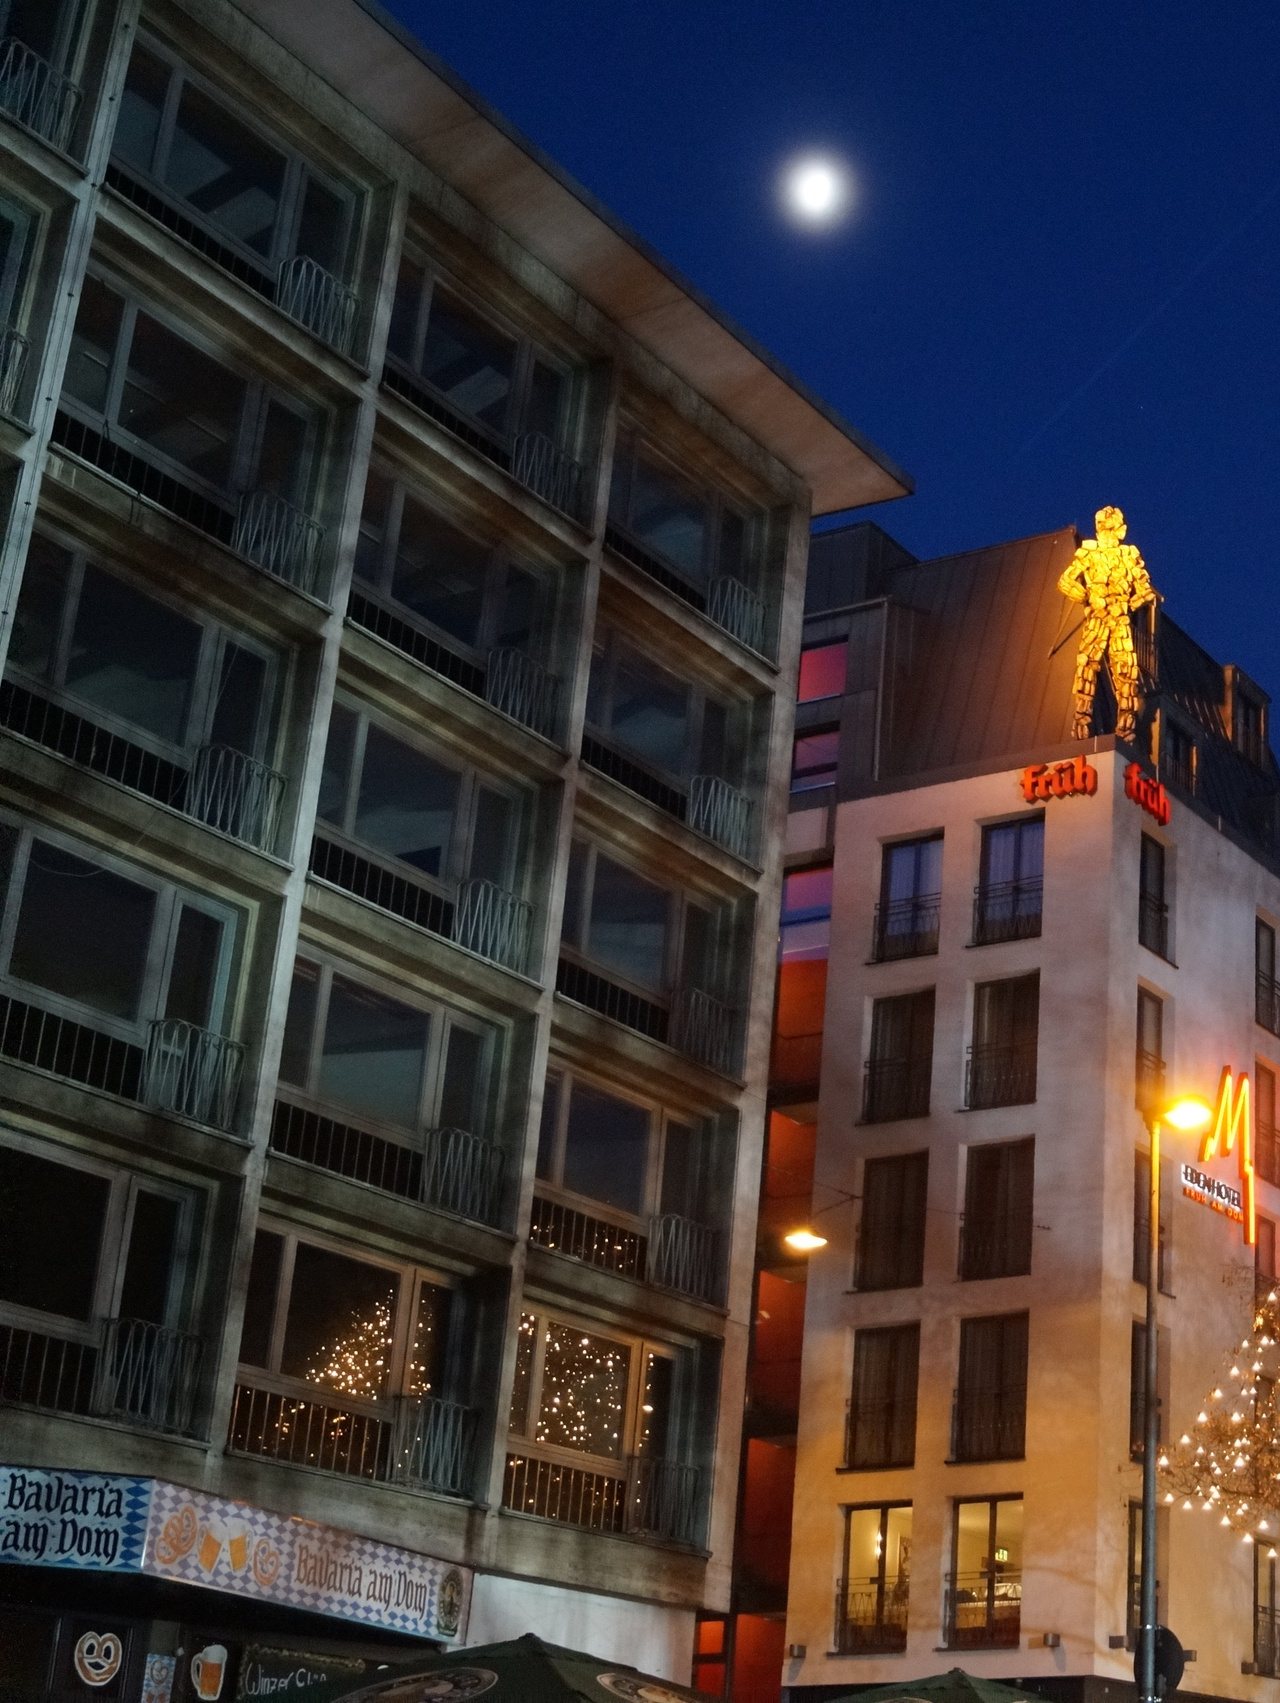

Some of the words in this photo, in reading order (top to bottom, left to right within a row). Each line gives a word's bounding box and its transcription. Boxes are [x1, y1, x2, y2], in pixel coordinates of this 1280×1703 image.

[4, 1472, 123, 1518] Bavaria
[2, 1519, 48, 1560] am
[55, 1517, 120, 1566] Dom
[295, 1544, 362, 1598] Bavaria
[366, 1568, 393, 1612] am
[394, 1569, 428, 1620] Dom
